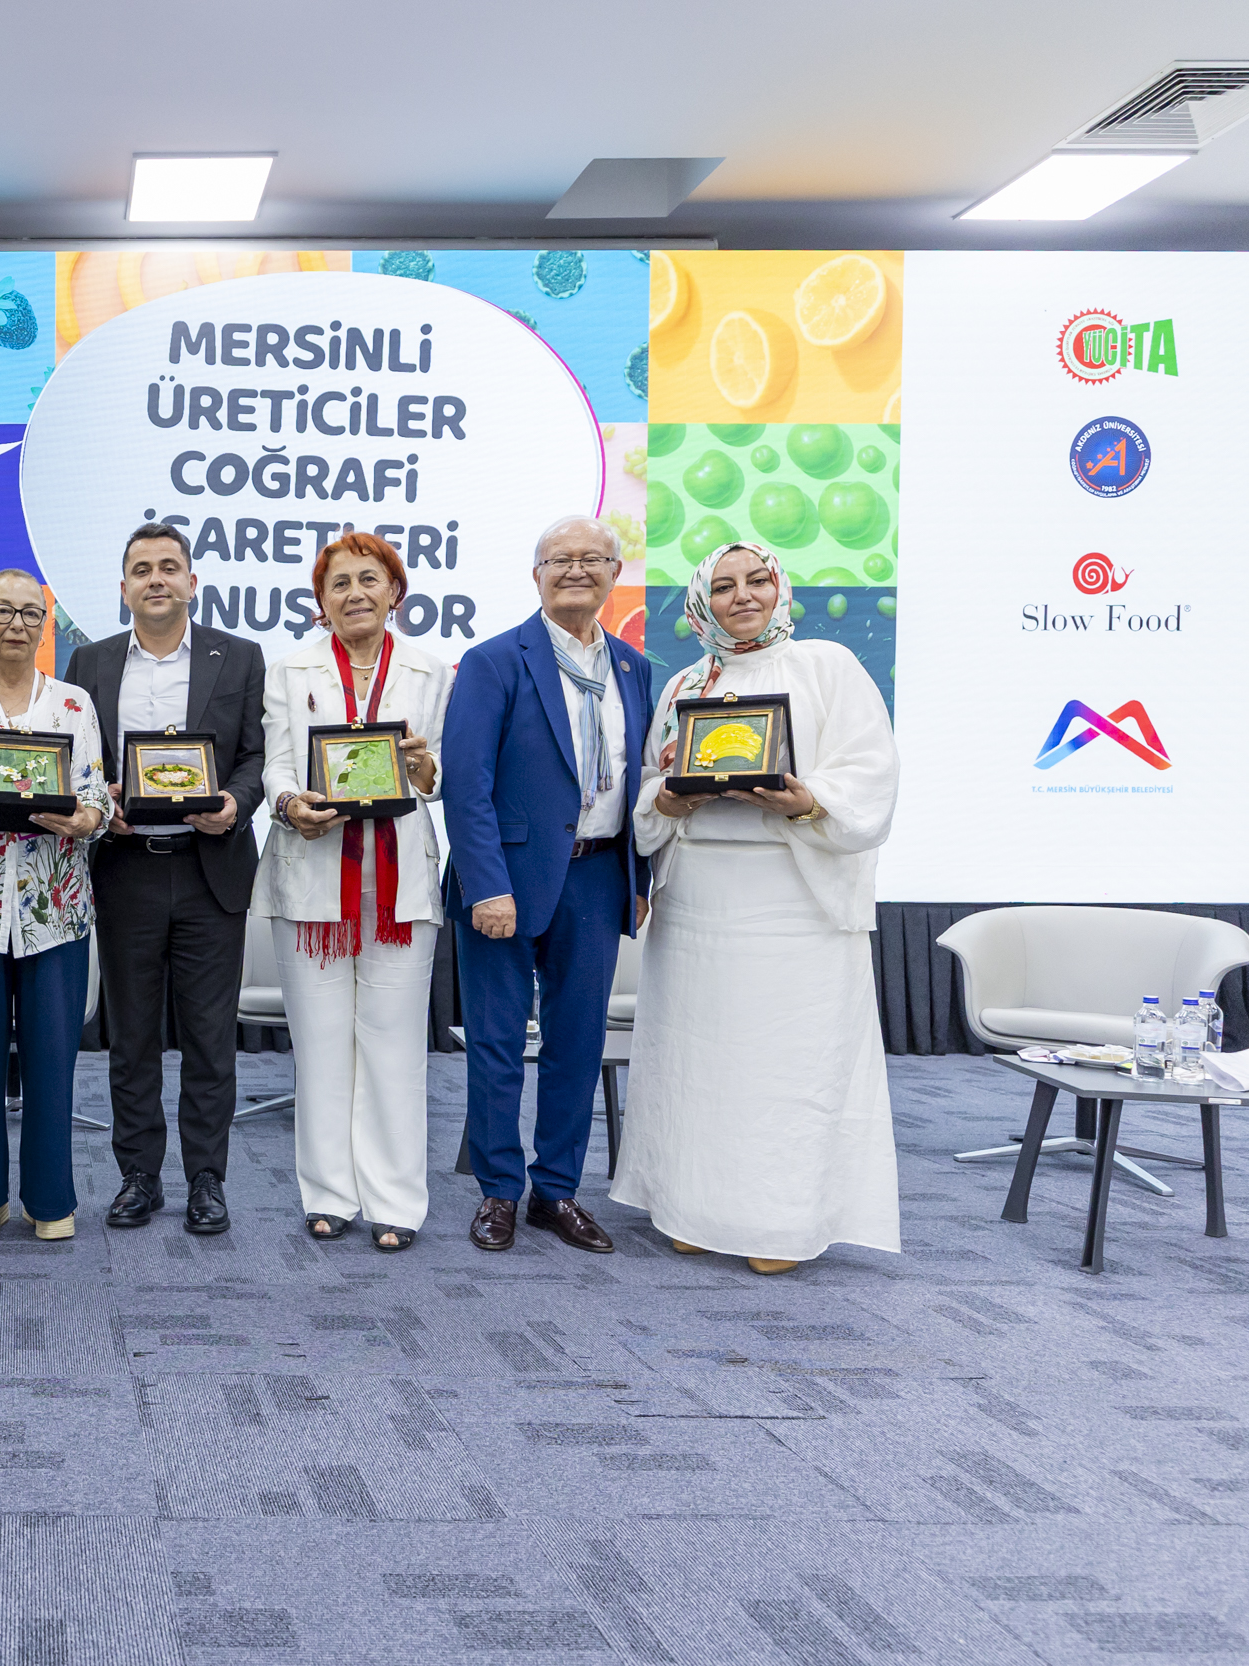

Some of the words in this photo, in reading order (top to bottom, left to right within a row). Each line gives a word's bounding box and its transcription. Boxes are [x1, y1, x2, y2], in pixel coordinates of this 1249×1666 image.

[168, 320, 433, 373] MERSİNLİ
[147, 375, 467, 441] ÜRETİCİLER
[1074, 423, 1102, 453] AKDENİZ
[1103, 420, 1147, 452] ÜNİVERSİTESİ
[170, 444, 419, 503] COĞRAFİ
[1021, 603, 1095, 632] Slow
[1046, 784, 1077, 793] MERSİN
[1079, 784, 1129, 795] BÜYÜKŞEHİR
[1131, 784, 1174, 793] BELEDİYESİ
